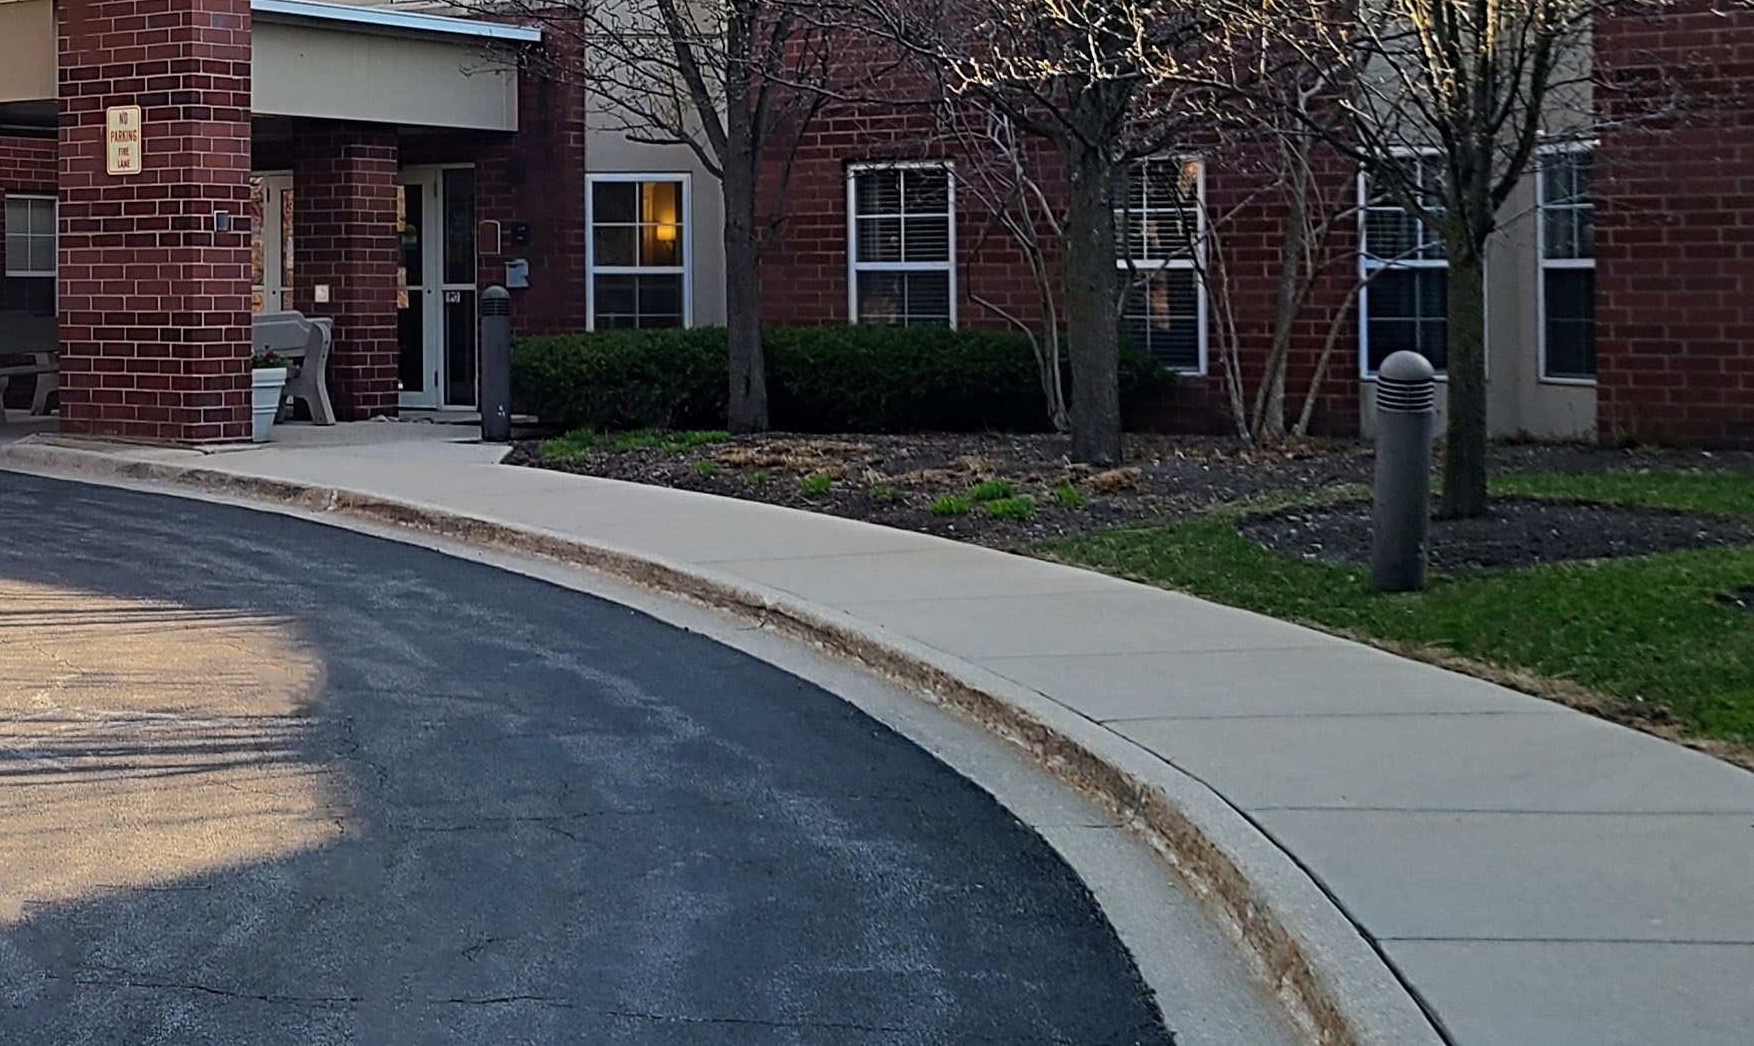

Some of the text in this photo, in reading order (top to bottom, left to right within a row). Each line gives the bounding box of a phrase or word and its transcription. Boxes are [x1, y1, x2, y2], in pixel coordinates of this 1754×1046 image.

[119, 112, 128, 125] NO
[111, 129, 137, 143] PARKING
[118, 147, 129, 156] FIRE
[118, 159, 130, 169] LANE
